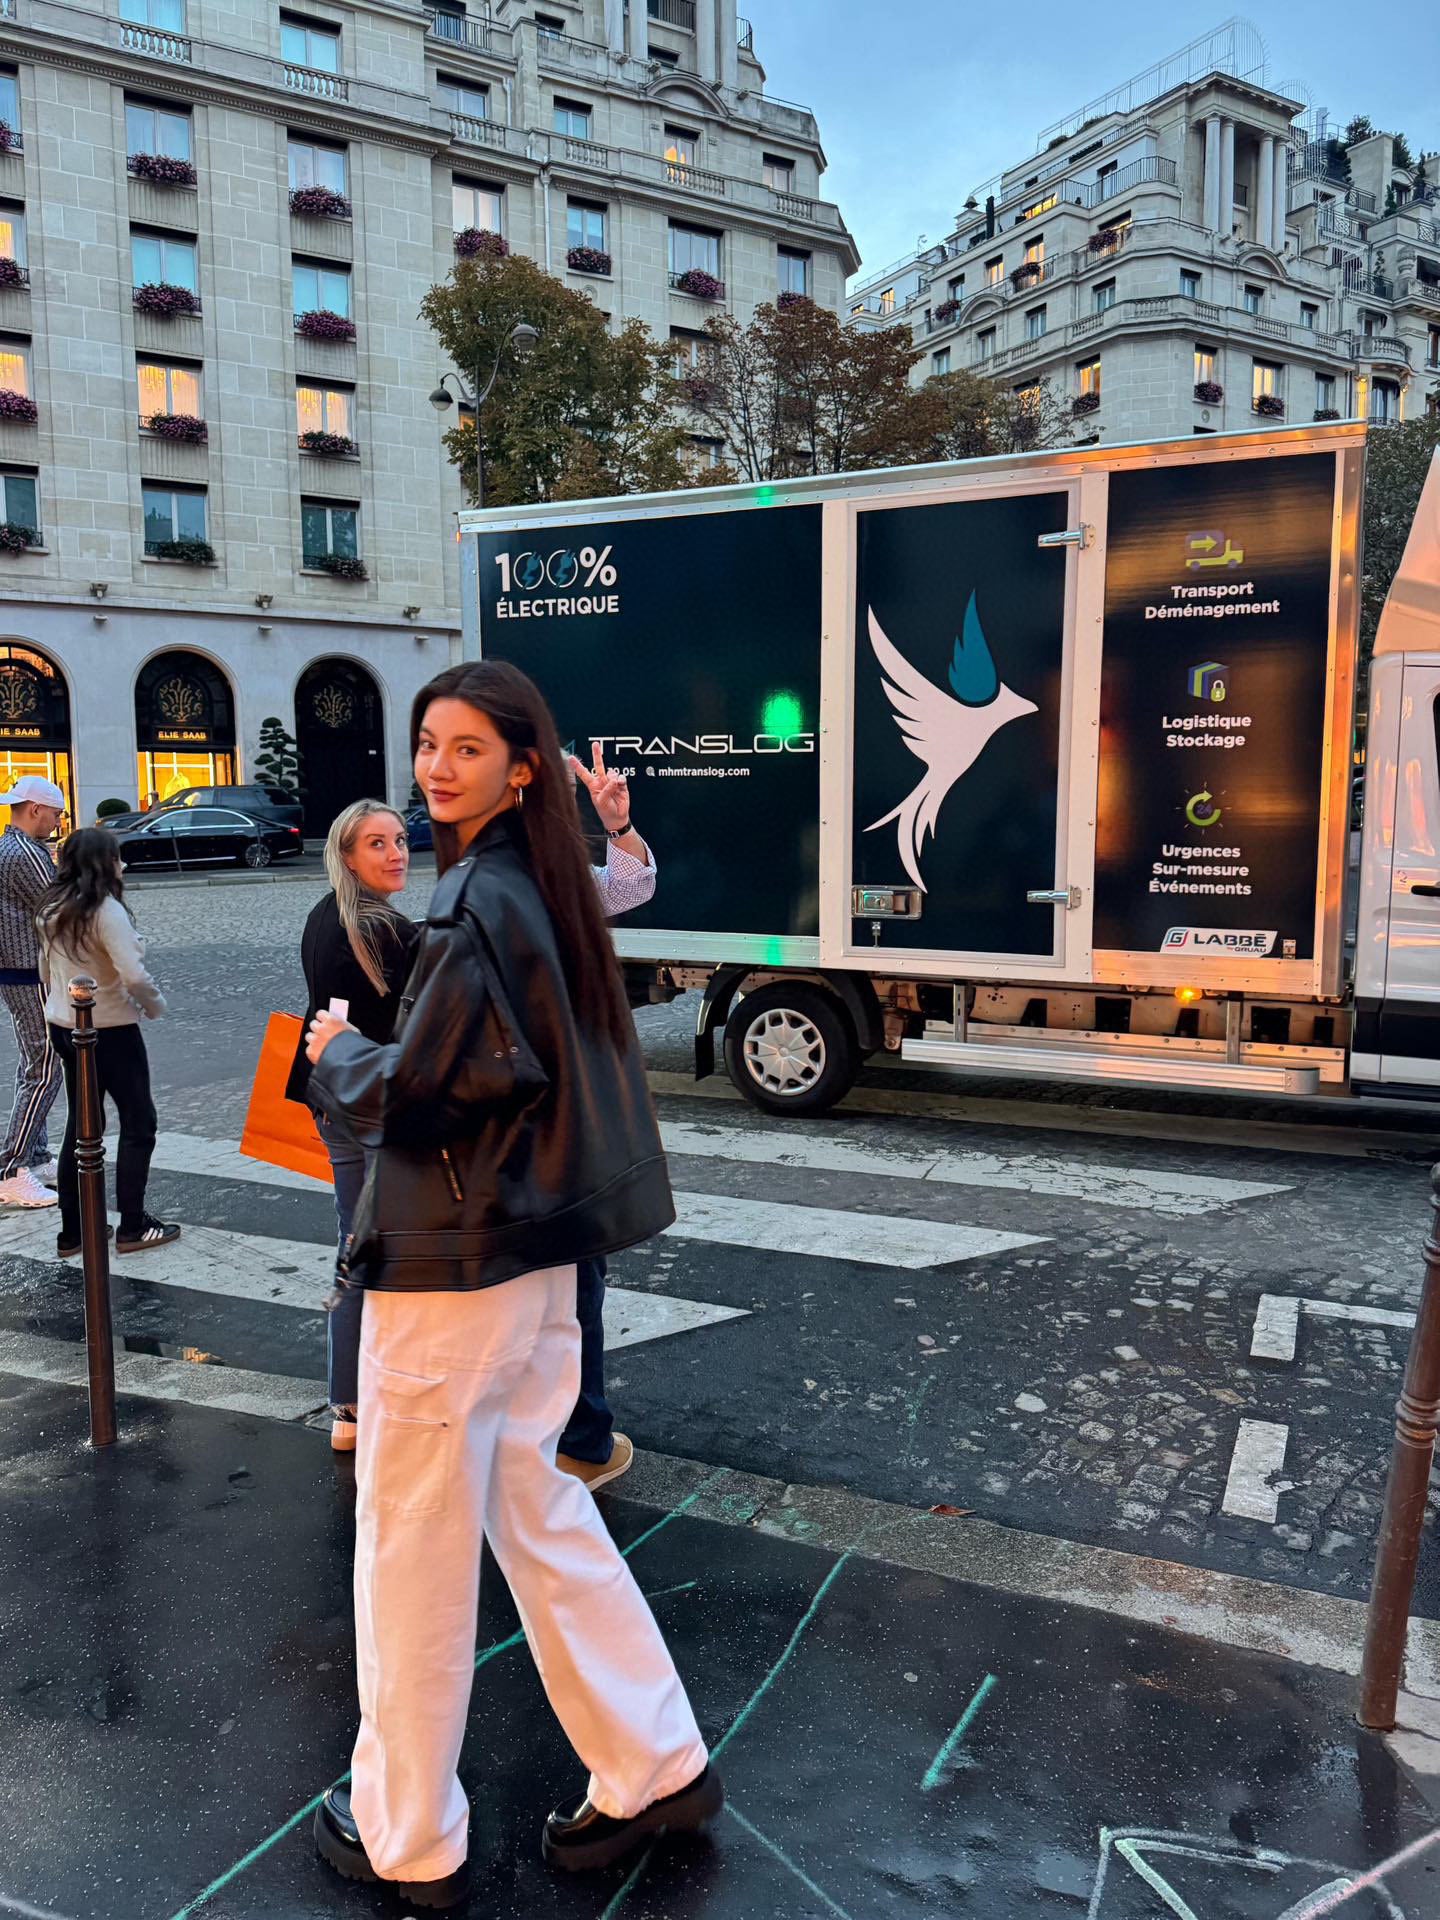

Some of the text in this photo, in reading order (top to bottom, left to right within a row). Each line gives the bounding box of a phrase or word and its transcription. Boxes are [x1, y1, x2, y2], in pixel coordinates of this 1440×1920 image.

[495, 545, 617, 592] 100%
[1171, 581, 1254, 598] Transport
[496, 595, 619, 618] ÉLECTRIQUE
[1144, 600, 1280, 619] Déménagement
[1162, 714, 1252, 730] Logistique
[15, 727, 40, 736] SAAB
[158, 731, 206, 739] ELIE SAAB
[588, 733, 814, 755] TRANSLOG
[1166, 733, 1245, 748] Stockage
[658, 766, 750, 778] mhmtranslog.com
[1162, 844, 1241, 859] Urgences
[1152, 862, 1249, 876] Sur-mesure
[1149, 877, 1252, 895] Événements
